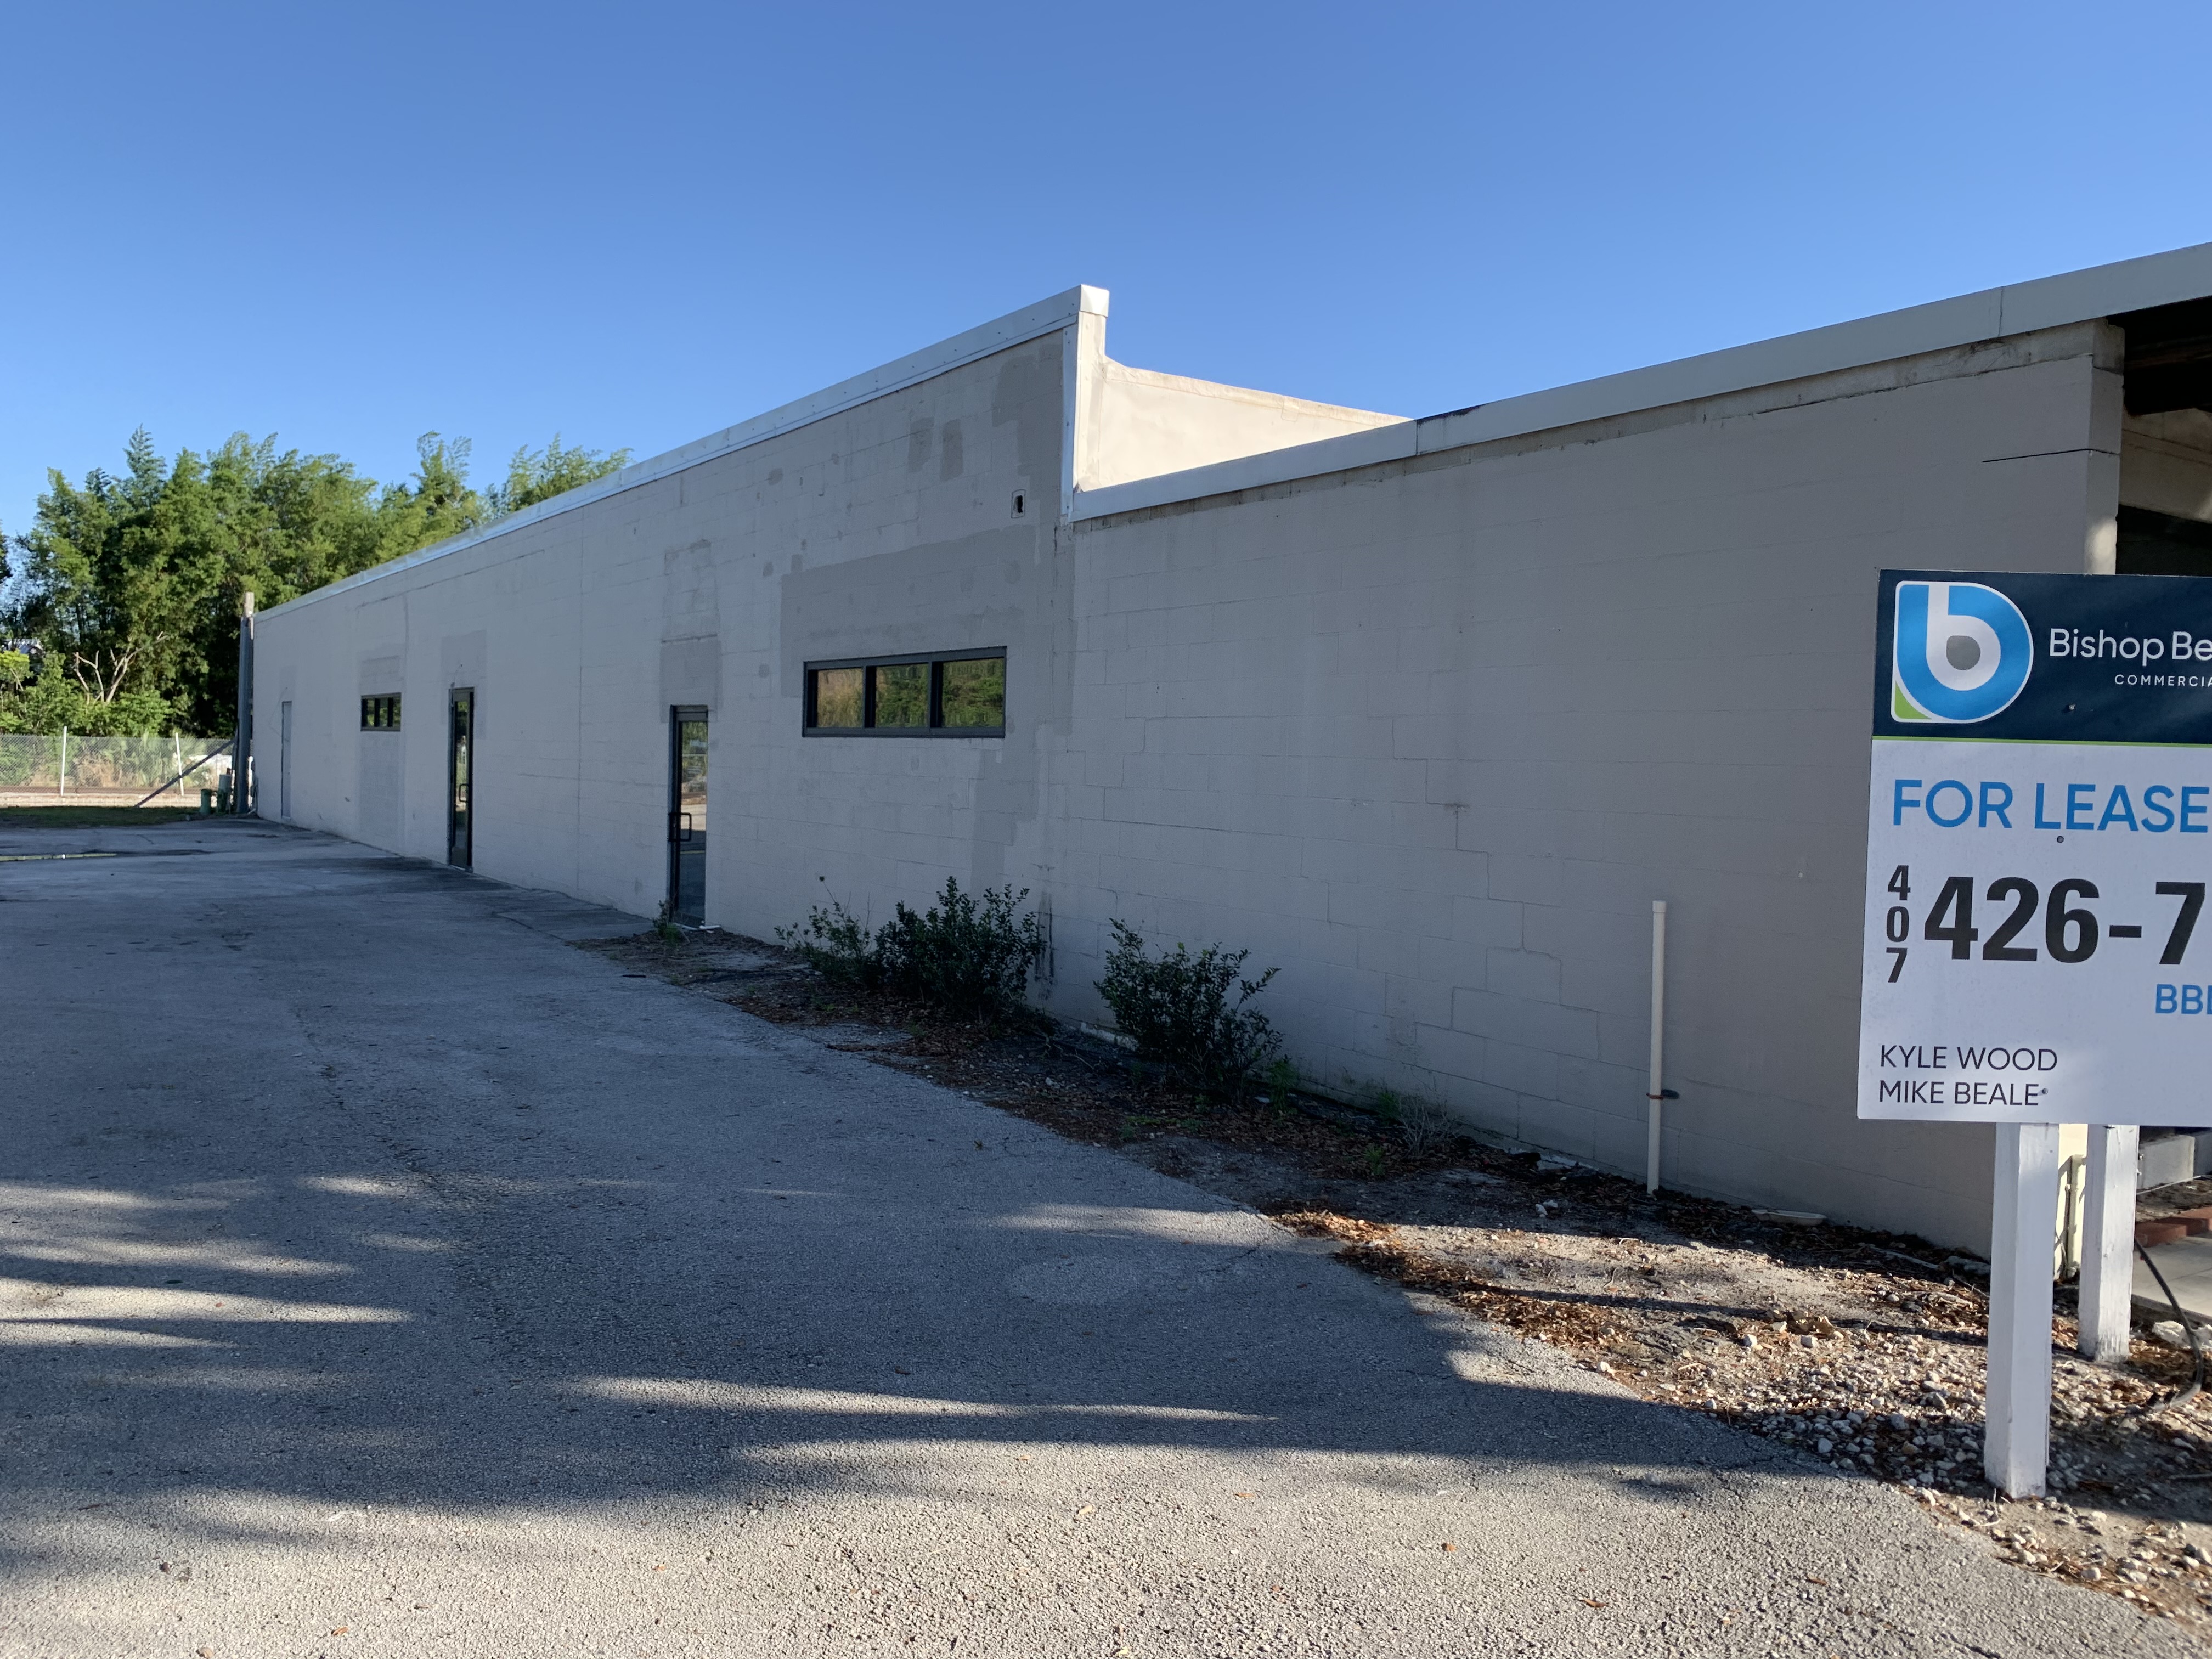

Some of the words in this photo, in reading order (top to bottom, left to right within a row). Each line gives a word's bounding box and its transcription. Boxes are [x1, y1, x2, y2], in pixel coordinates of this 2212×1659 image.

[2049, 628, 2165, 667] Bishop
[1893, 779, 2013, 829] FOR
[2034, 782, 2210, 833] LEASE
[1923, 876, 2206, 965] 426-7
[1880, 1045, 1948, 1069] KYLE
[1956, 1047, 2058, 1071] WOOD
[1878, 1080, 1945, 1104] MIKE
[1954, 1082, 2040, 1107] BEALE
